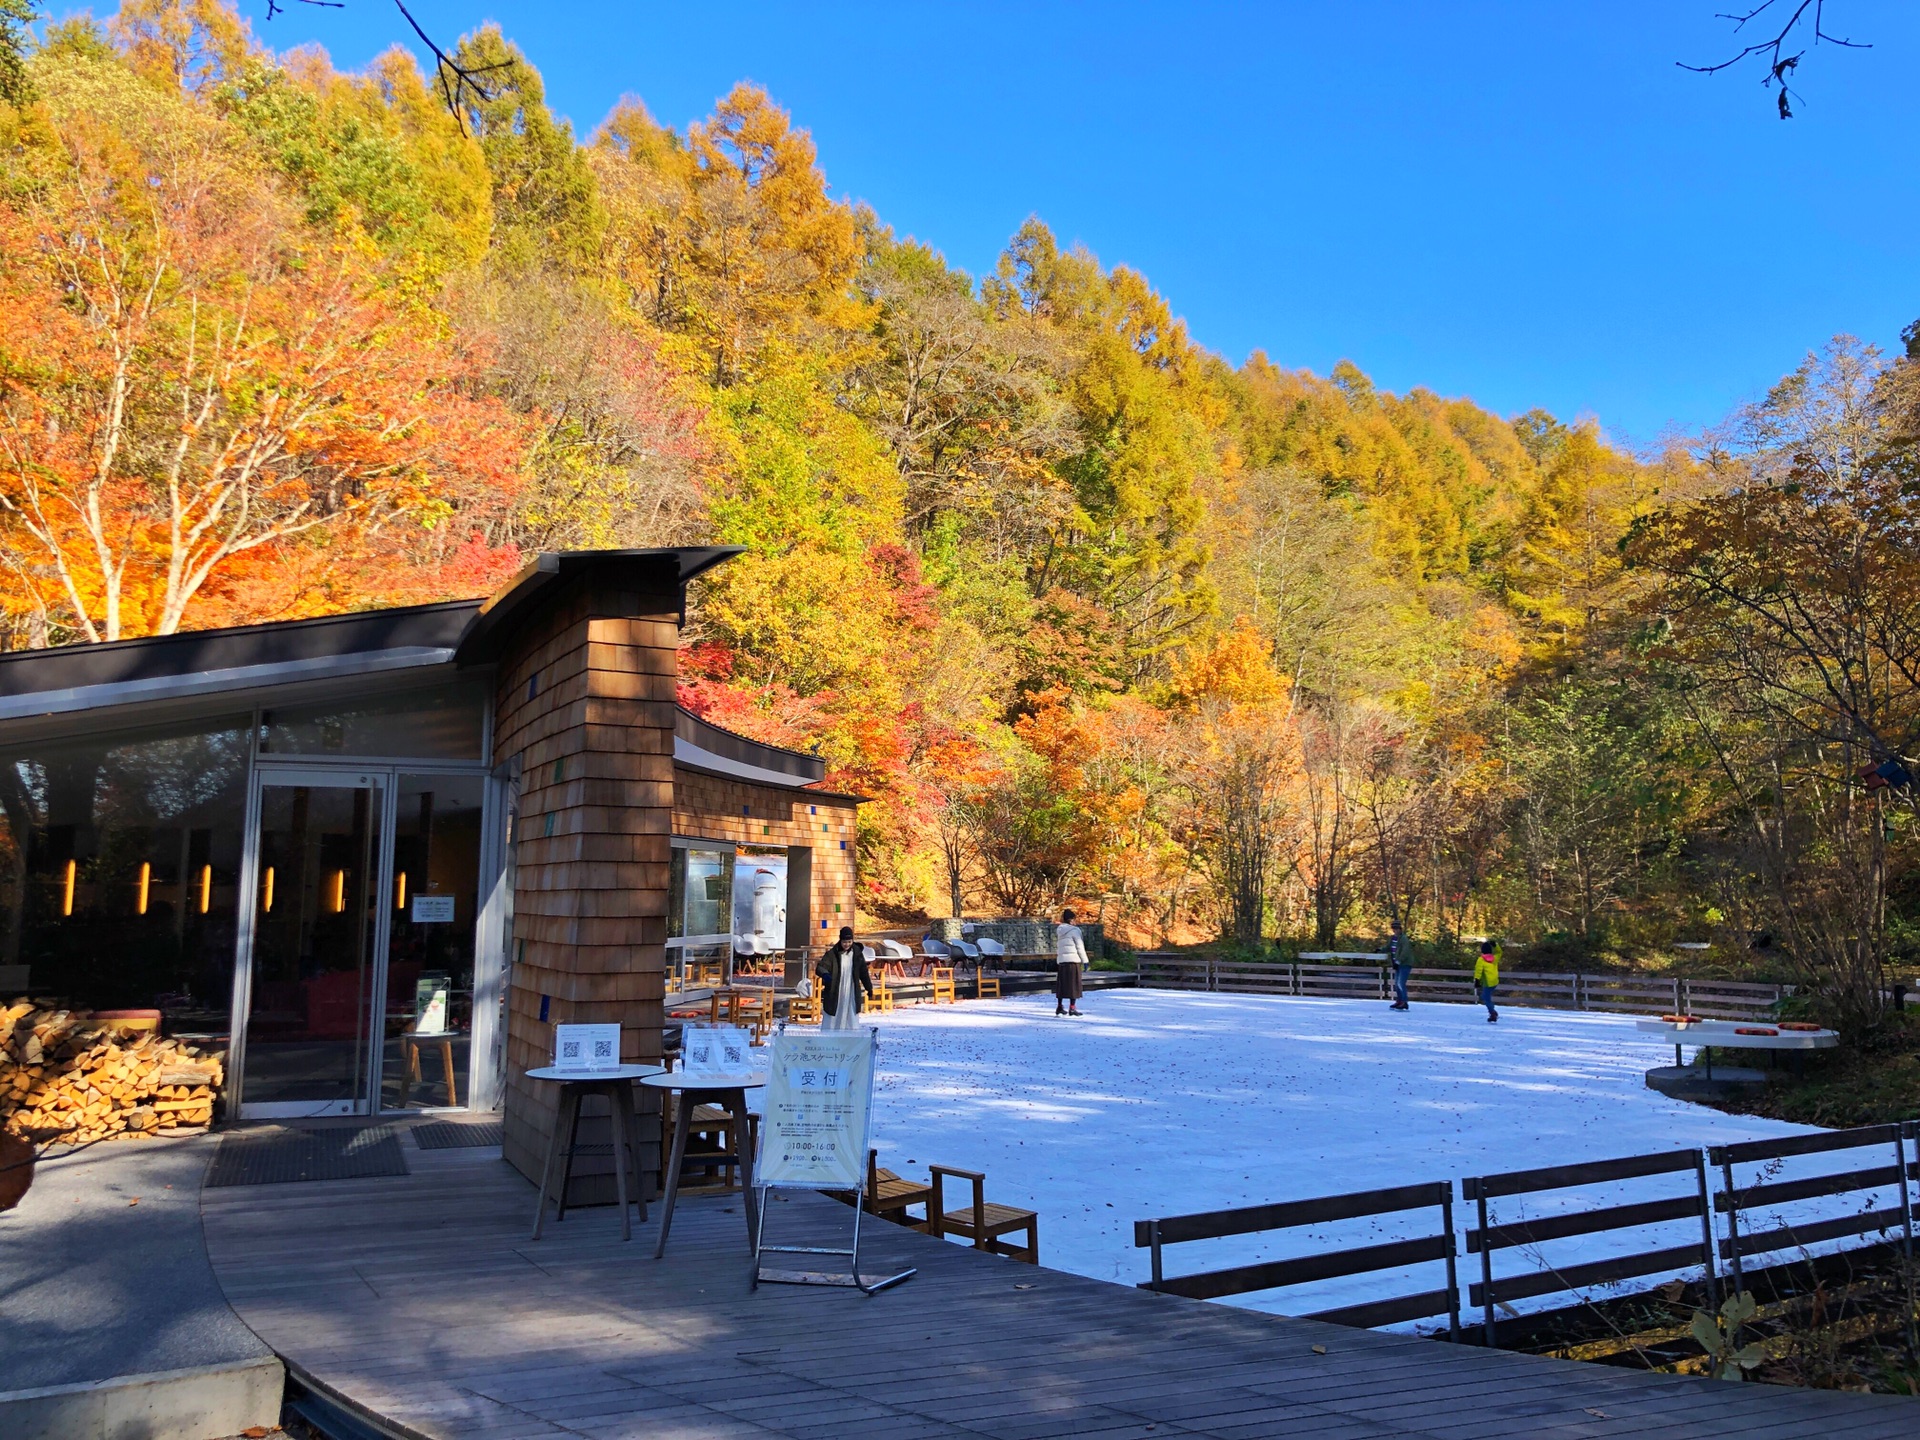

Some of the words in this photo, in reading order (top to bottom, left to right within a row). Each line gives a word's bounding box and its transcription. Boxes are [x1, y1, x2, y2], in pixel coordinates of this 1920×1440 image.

[783, 1052, 861, 1063] ケラ池スケートリンク
[801, 1070, 838, 1087] 受付
